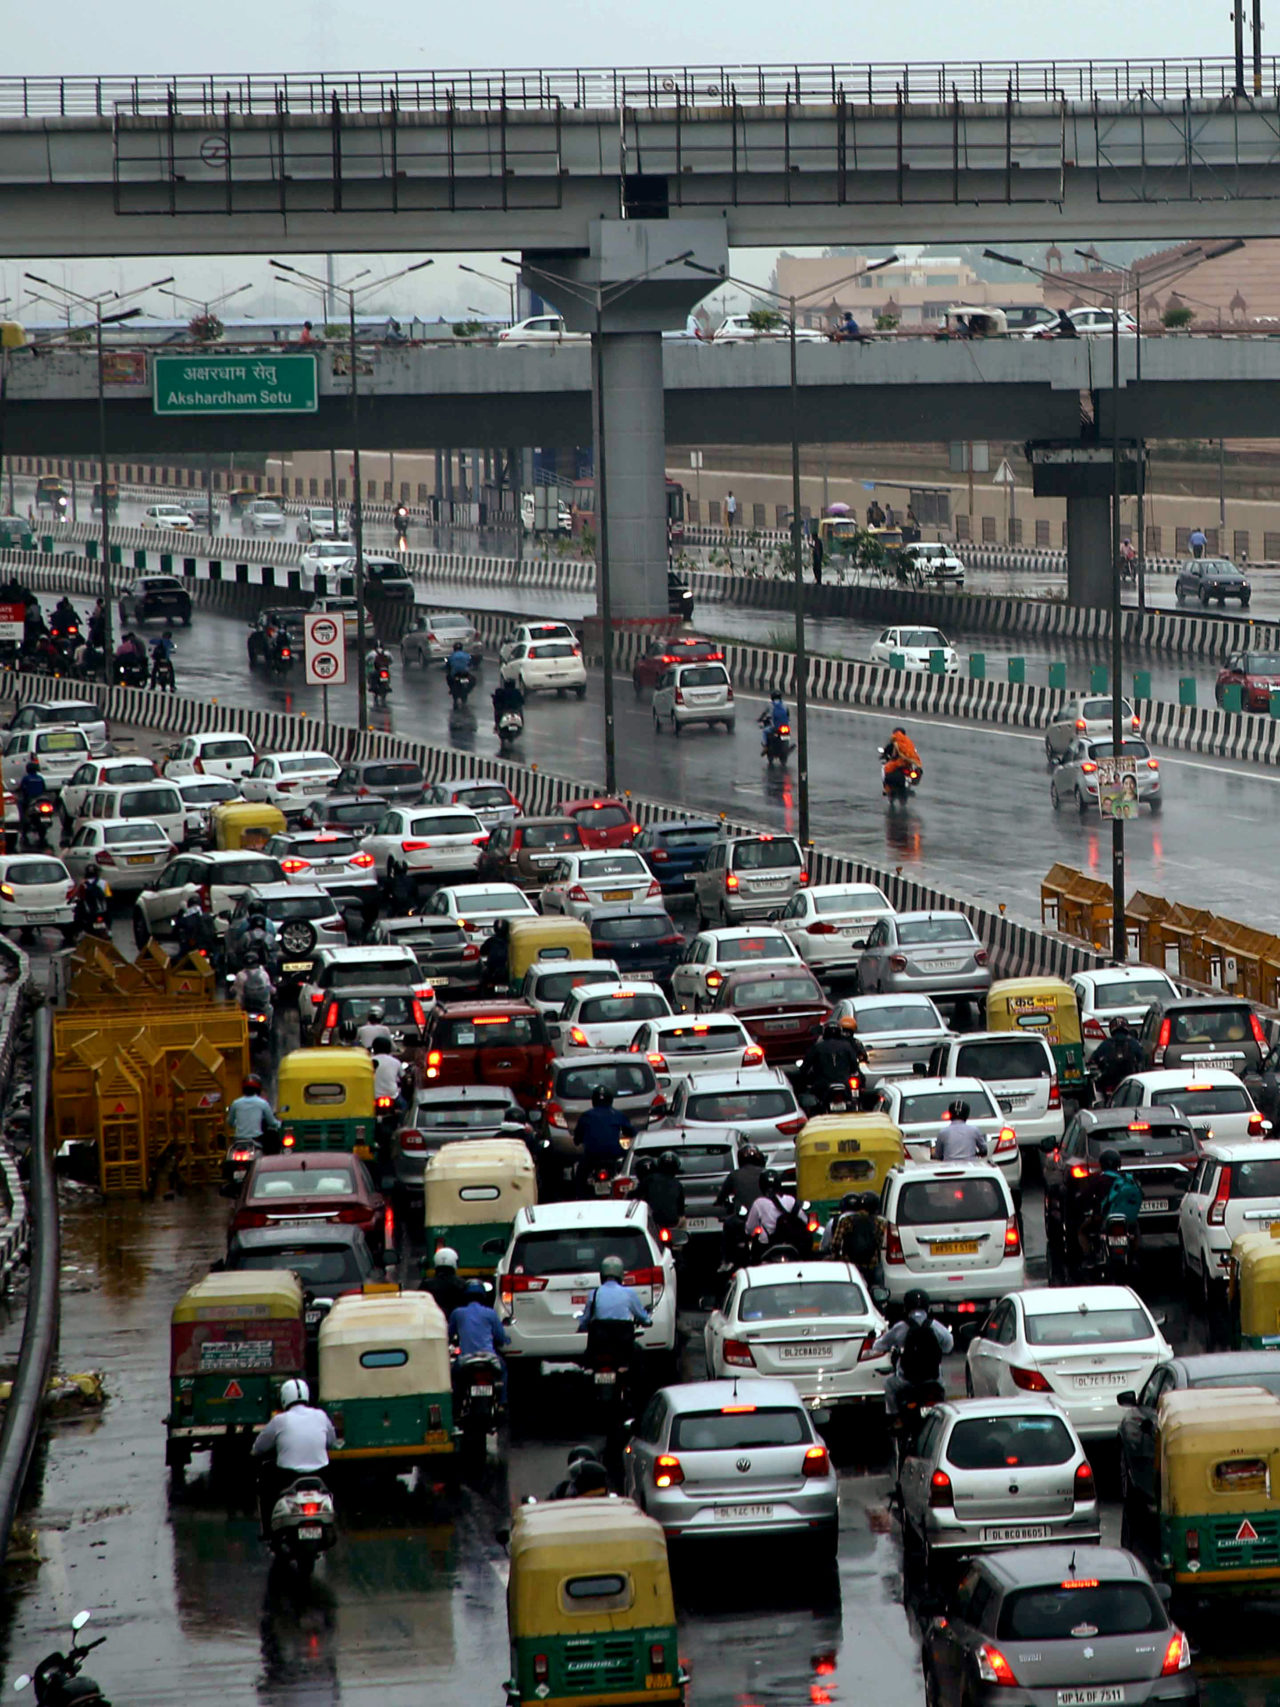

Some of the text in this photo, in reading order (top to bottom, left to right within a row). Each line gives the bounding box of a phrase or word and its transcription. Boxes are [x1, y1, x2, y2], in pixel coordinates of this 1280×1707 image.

[184, 365, 278, 385] अक्षरधाम सेतु
[167, 389, 292, 406] Akshardham Setu
[321, 633, 330, 641] 70
[1227, 959, 1234, 970] 6
[1062, 1691, 1073, 1703] UP
